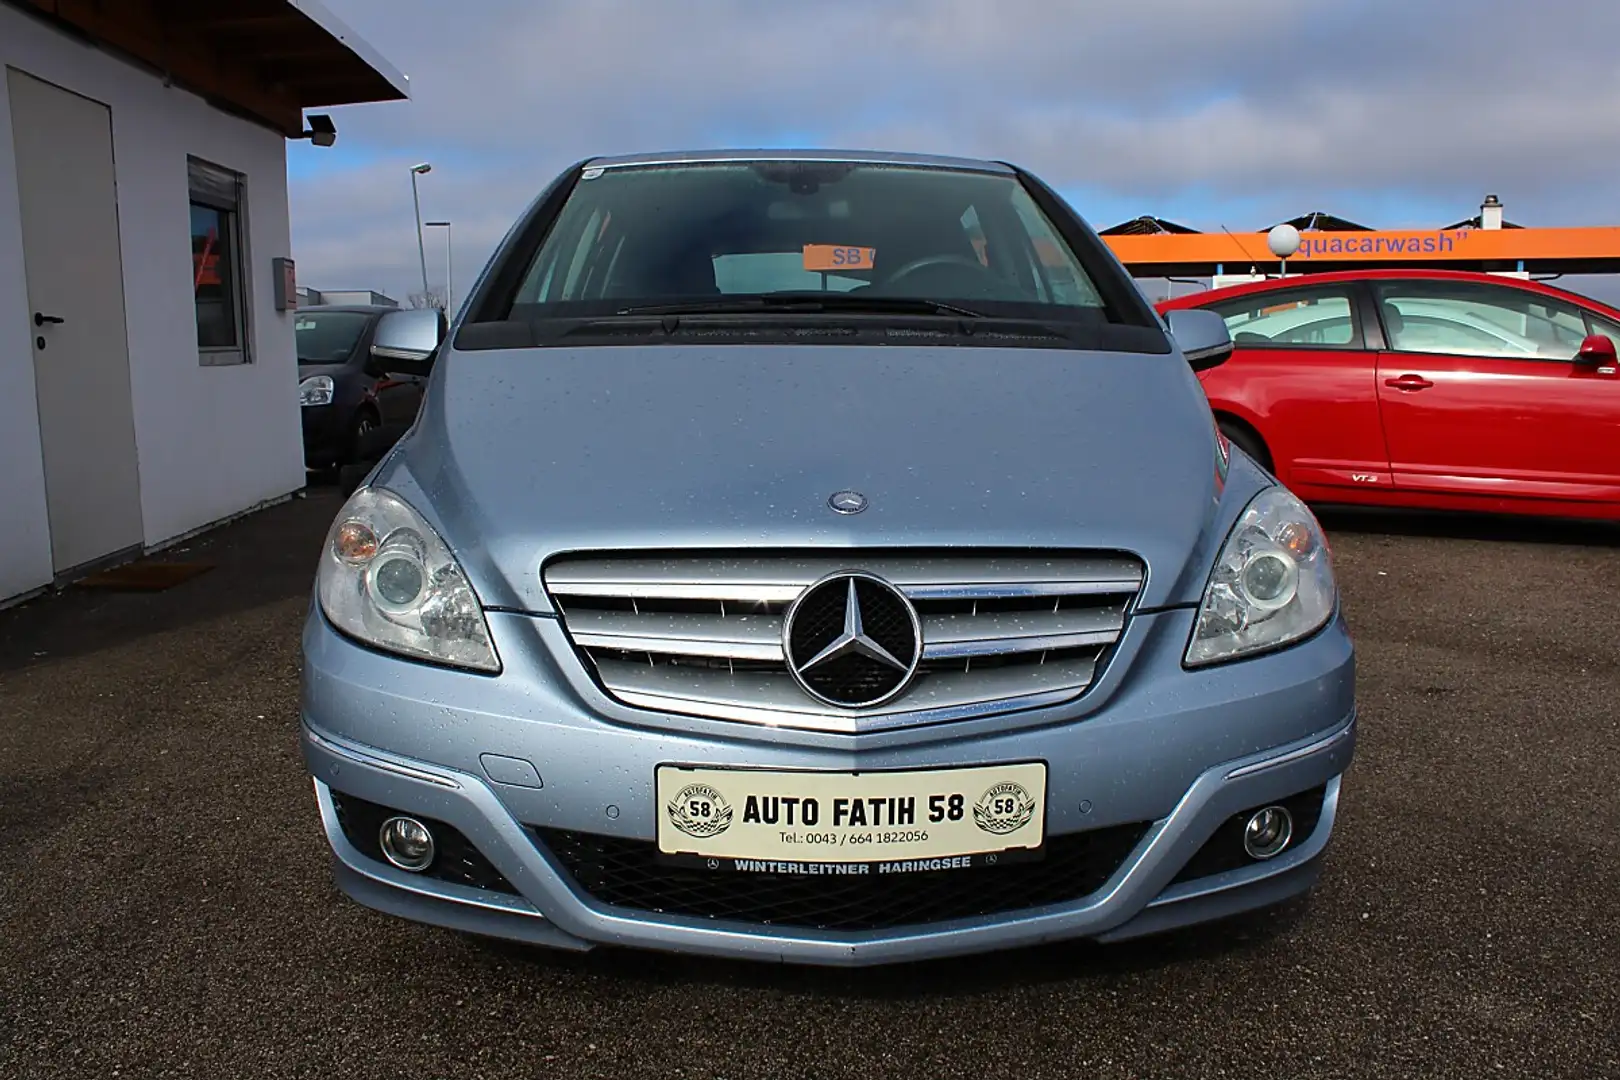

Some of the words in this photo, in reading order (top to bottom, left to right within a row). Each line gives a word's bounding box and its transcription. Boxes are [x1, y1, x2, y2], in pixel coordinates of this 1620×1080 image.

[1296, 231, 1467, 258] quacarwash”
[832, 248, 861, 265] SB
[1352, 473, 1377, 482] VTS
[690, 801, 711, 818] 58
[742, 795, 819, 826] AUTO
[833, 796, 915, 827] FATIH
[928, 793, 964, 823] 58
[994, 798, 1014, 815] 58
[779, 832, 803, 844] Tel.:
[806, 832, 837, 844] 0043
[849, 832, 872, 845] 664
[876, 830, 928, 844] 1822056
[734, 859, 869, 875] WINTERLEITNER
[879, 856, 971, 874] HARINGSEE
